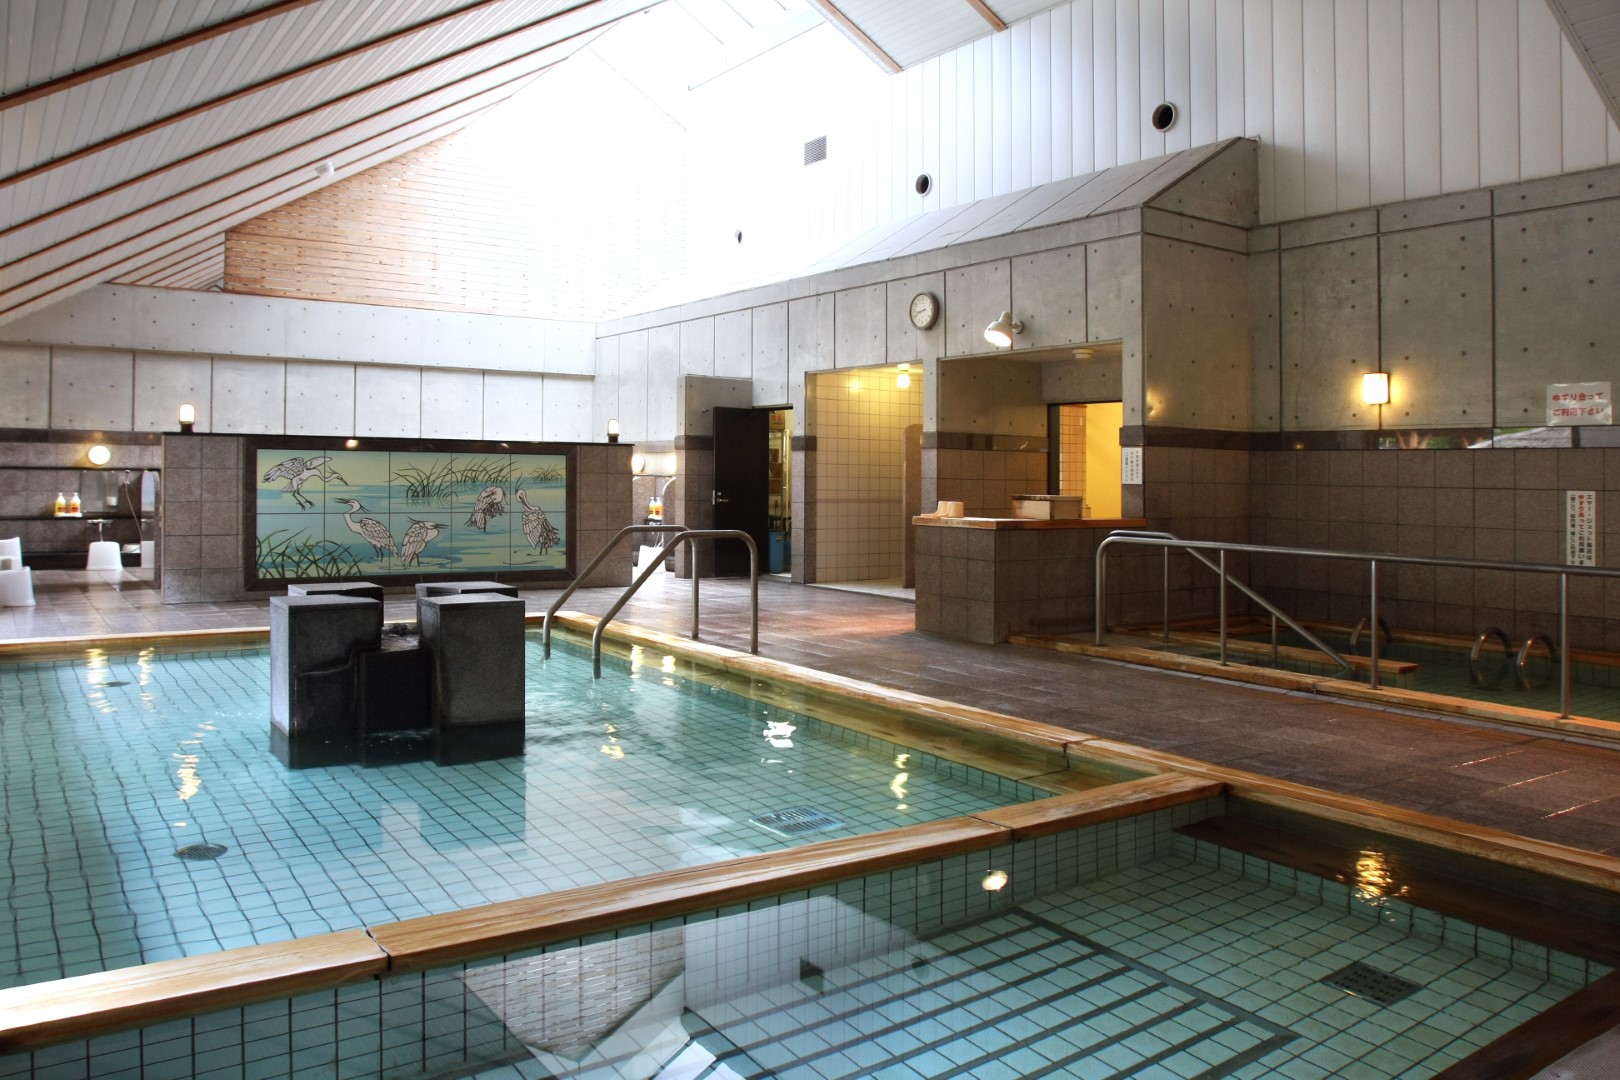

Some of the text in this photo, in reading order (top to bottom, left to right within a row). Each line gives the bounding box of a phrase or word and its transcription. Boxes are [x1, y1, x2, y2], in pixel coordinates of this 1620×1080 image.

[1552, 392, 1604, 401] ゆずり合って
[1553, 408, 1605, 416] ご利用下さい
